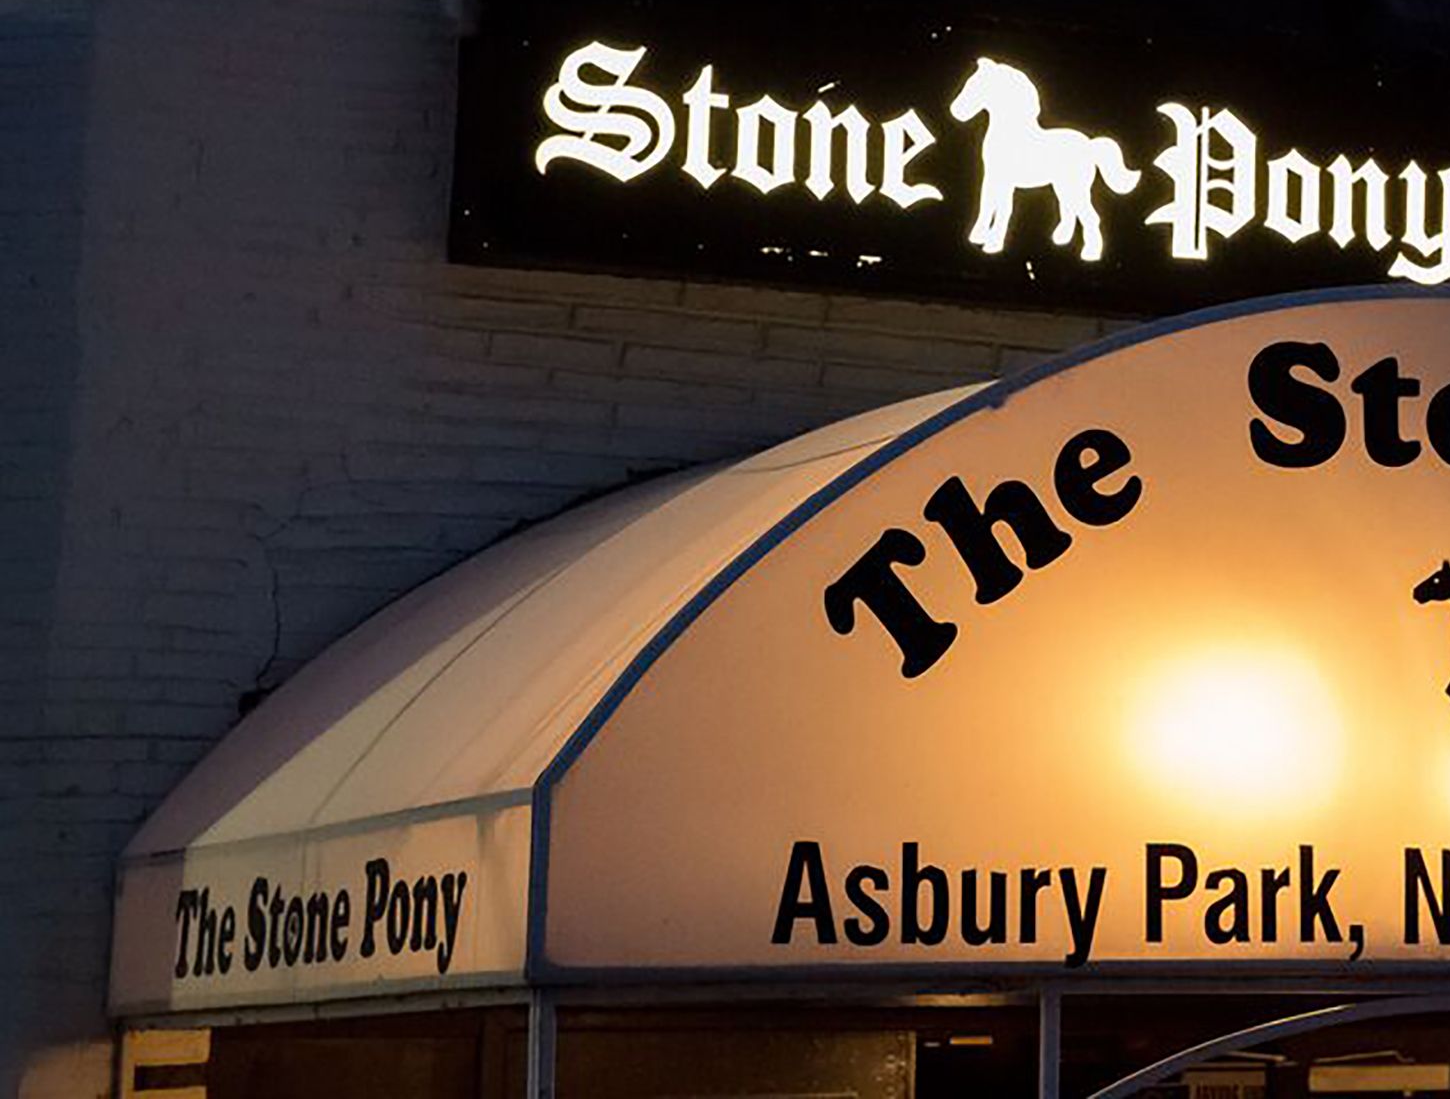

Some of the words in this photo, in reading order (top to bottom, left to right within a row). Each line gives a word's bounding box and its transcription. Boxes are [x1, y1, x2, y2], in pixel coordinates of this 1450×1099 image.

[533, 39, 944, 209] Stone
[823, 428, 1143, 679] The
[174, 885, 235, 978] The
[243, 875, 351, 973] Stone
[360, 857, 468, 974] Pony
[770, 840, 1108, 969] Asbury
[1145, 843, 1366, 962] Park,
